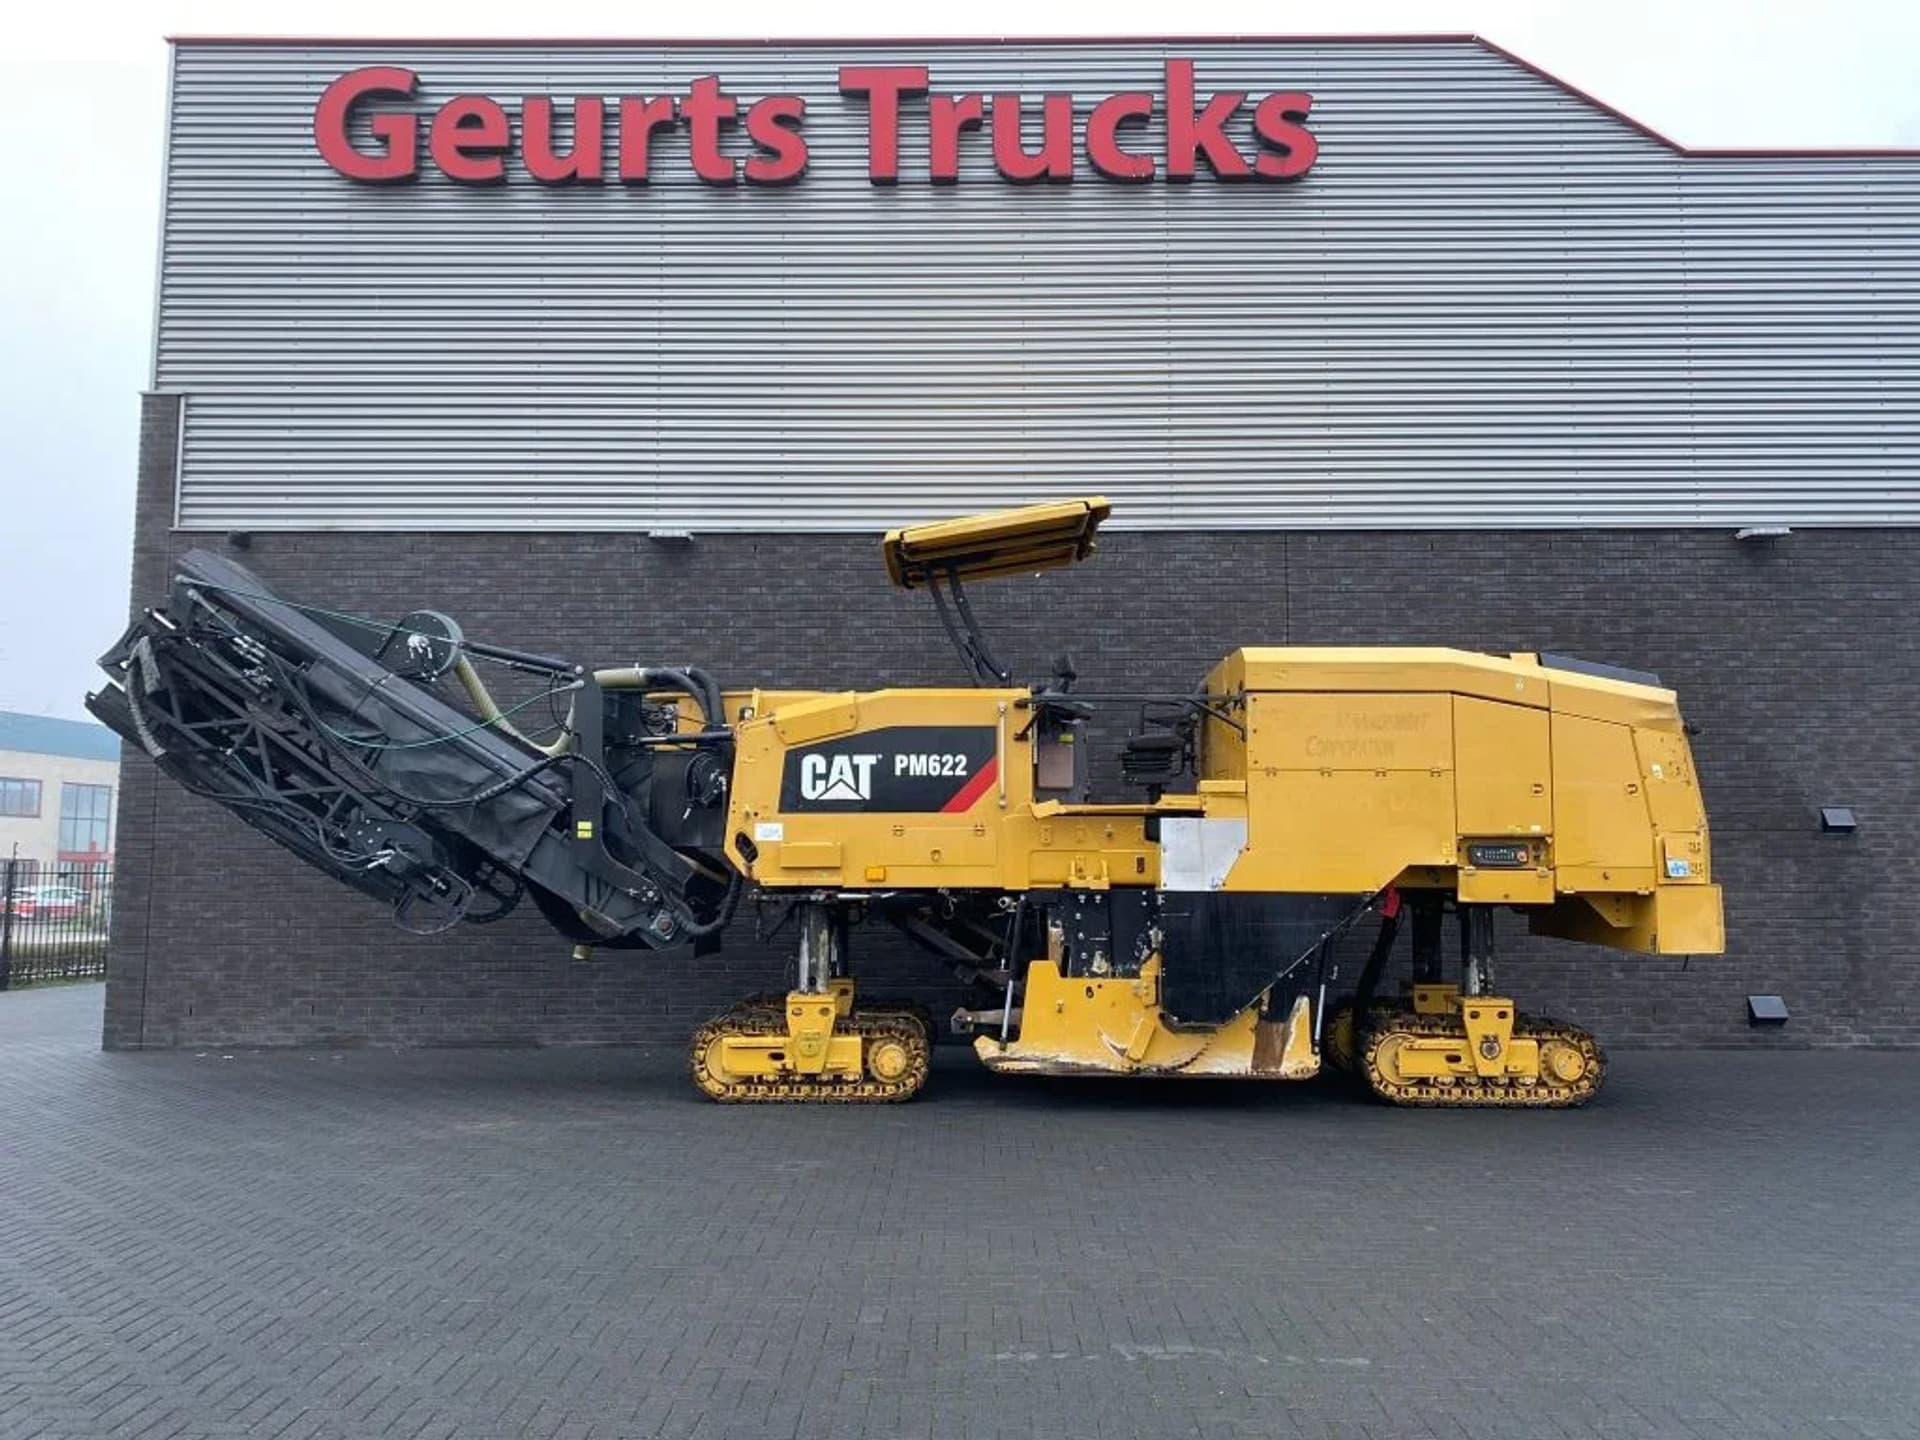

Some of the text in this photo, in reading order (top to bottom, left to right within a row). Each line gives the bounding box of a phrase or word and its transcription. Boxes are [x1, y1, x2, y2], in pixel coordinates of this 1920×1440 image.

[314, 59, 1318, 185] Geurts Trucks
[801, 754, 967, 800] CAT PM622
